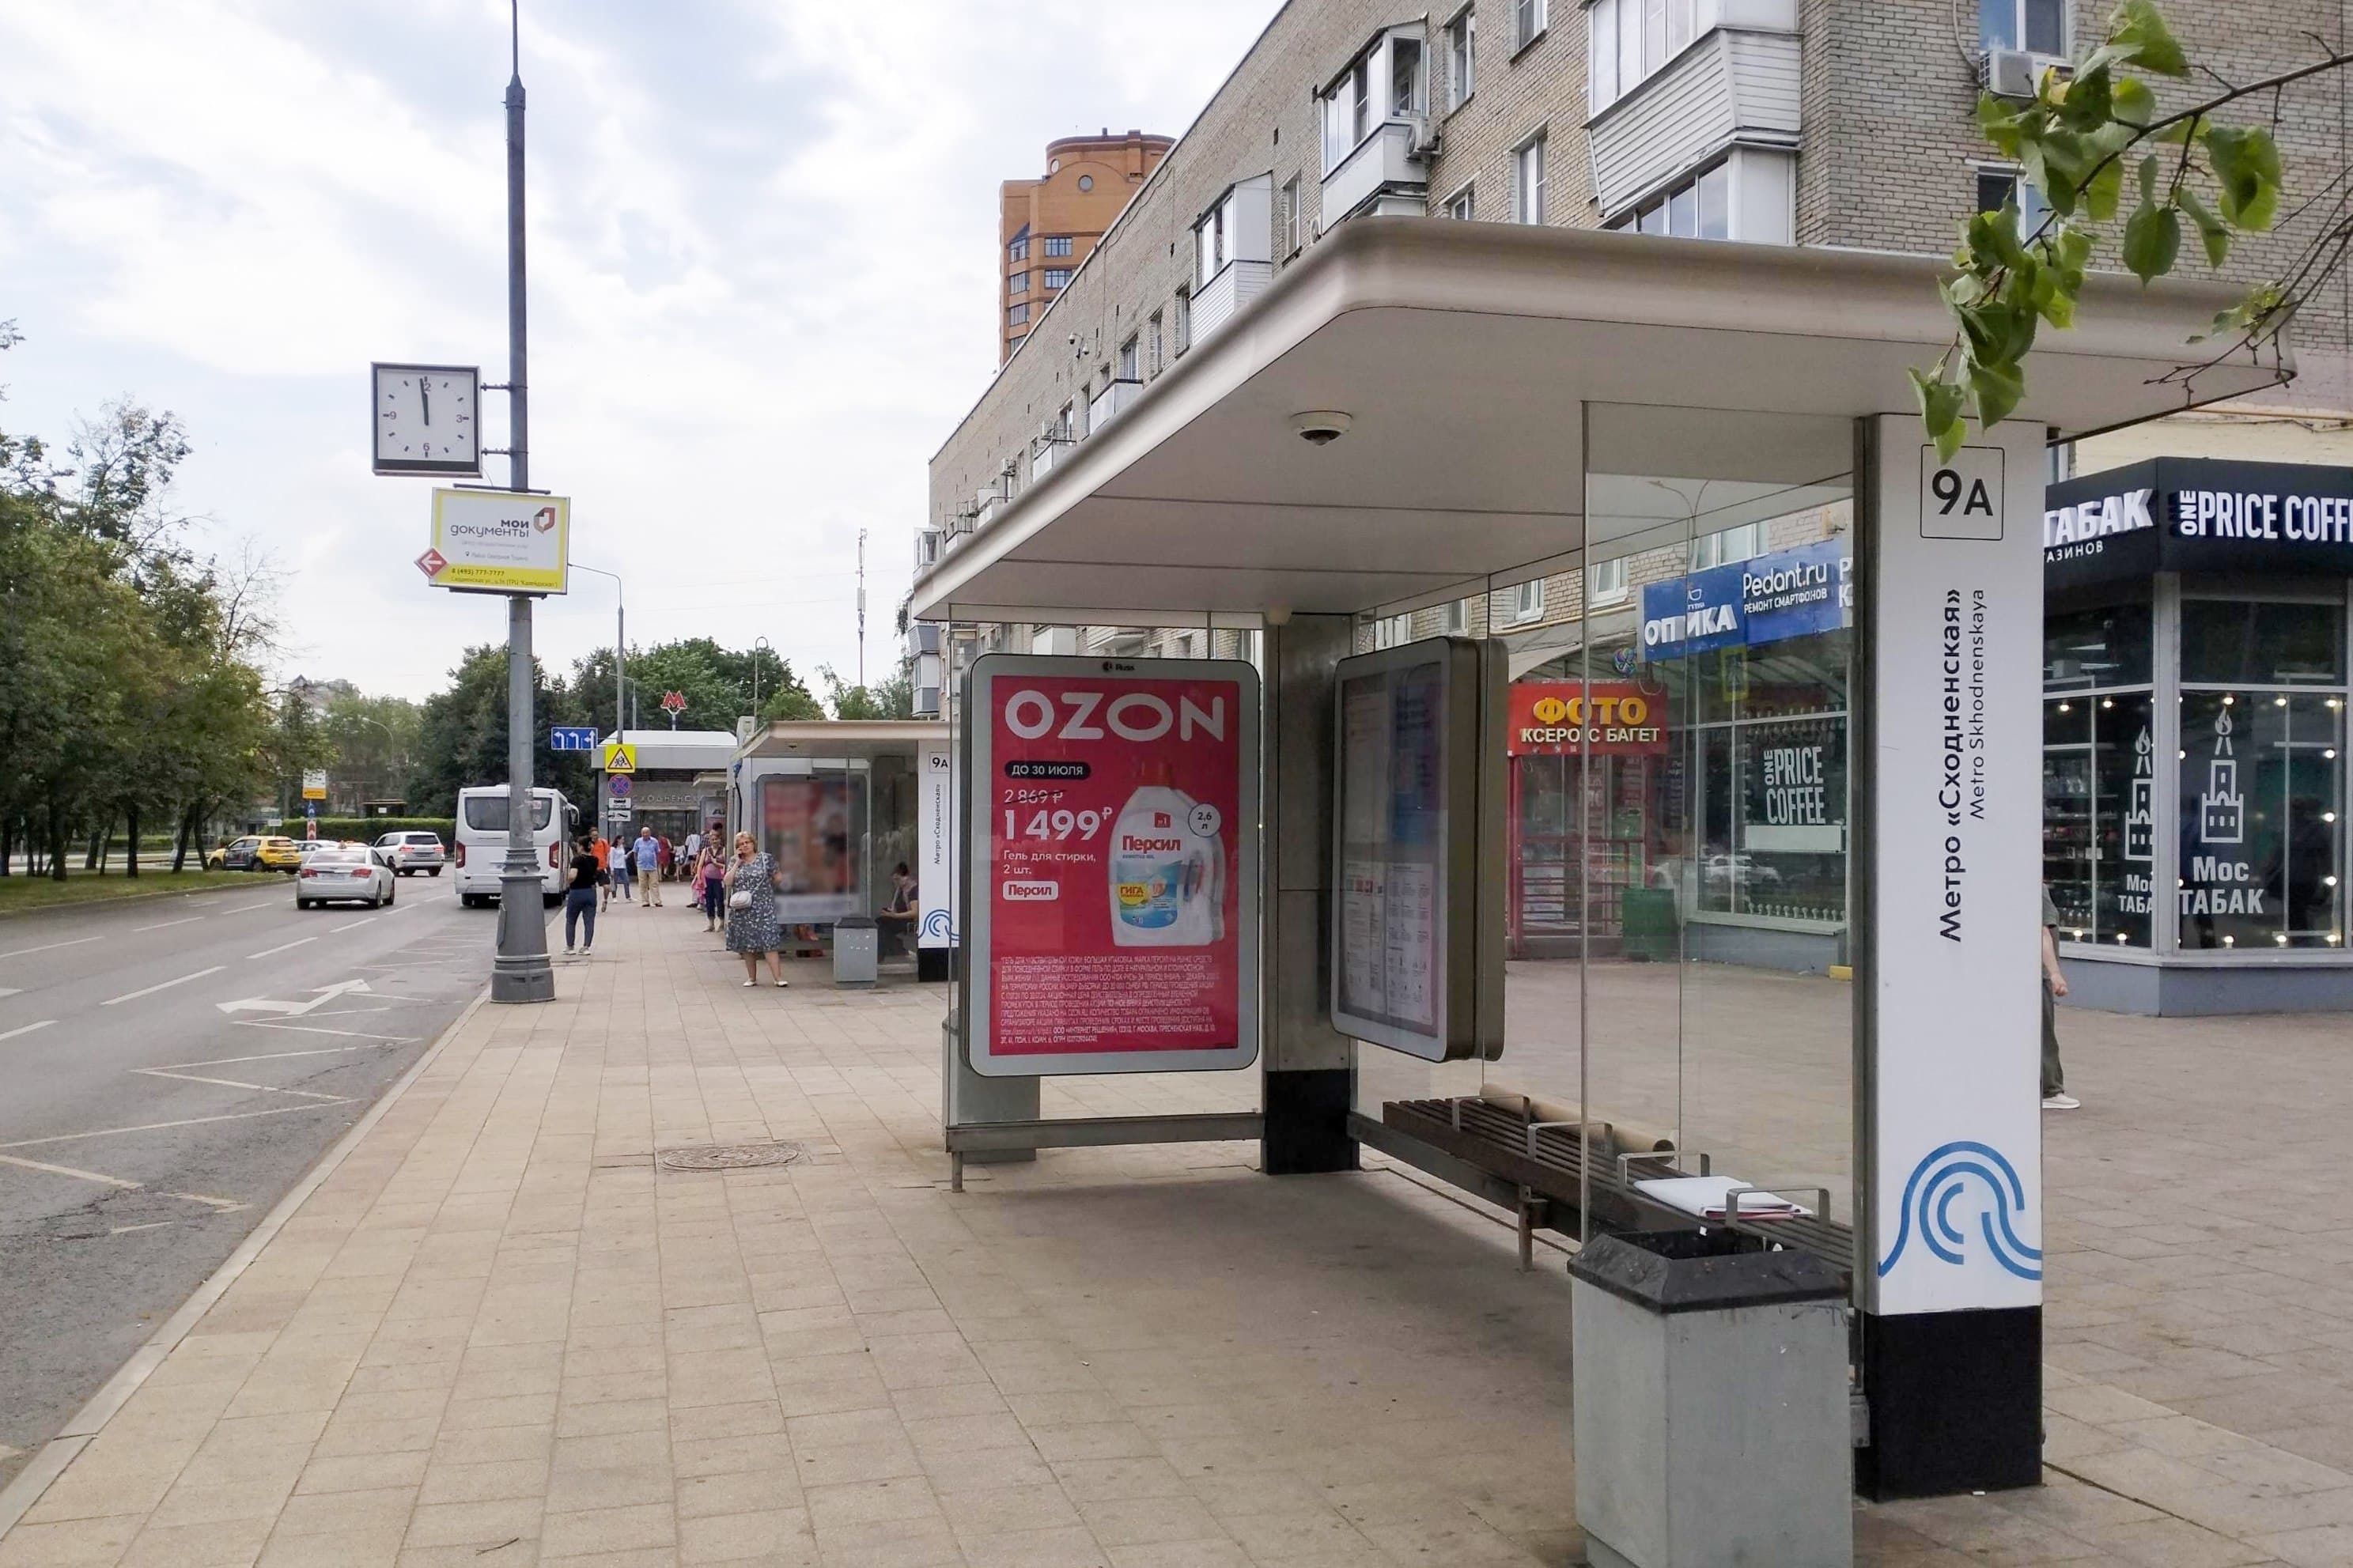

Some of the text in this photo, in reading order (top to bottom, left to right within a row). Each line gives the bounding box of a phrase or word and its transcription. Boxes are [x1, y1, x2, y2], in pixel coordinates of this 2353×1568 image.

[456, 414, 463, 423] 3
[423, 442, 430, 452] 6
[2180, 490, 2198, 535] ONE
[2199, 491, 2278, 538] PRICE
[2044, 540, 2103, 563] АЗИНОВ
[1743, 561, 1827, 599] Pedant.ru
[1744, 588, 1828, 614] РЕМОНТ СМАРТФОНОВ
[1969, 590, 1988, 750] Skhodnenskaya
[1004, 690, 1224, 742] OZON
[1533, 697, 1647, 726] ФОТО
[1939, 588, 1964, 826] «Сходненская»
[1520, 727, 1660, 742] КСЕРОС БАГЕТ
[1012, 765, 1083, 776] ДО 30 ИЮЛЯ
[1774, 746, 1824, 785] PRICE
[1969, 757, 1984, 819] Metro
[1197, 812, 1212, 822] 2,6
[1766, 787, 1826, 825] COFFEE
[1004, 849, 1096, 863] Гель для стирки,
[1122, 834, 1181, 855] Персил
[1003, 863, 1032, 875] 2 шт.
[2192, 856, 2249, 882] Мос
[1008, 884, 1053, 898] Персил
[1120, 886, 1144, 894] ГИГА
[1939, 836, 1966, 943] Метро
[2126, 874, 2153, 893] Мо
[2117, 894, 2153, 914] ТАБА
[2180, 889, 2264, 914] ТАБАК
